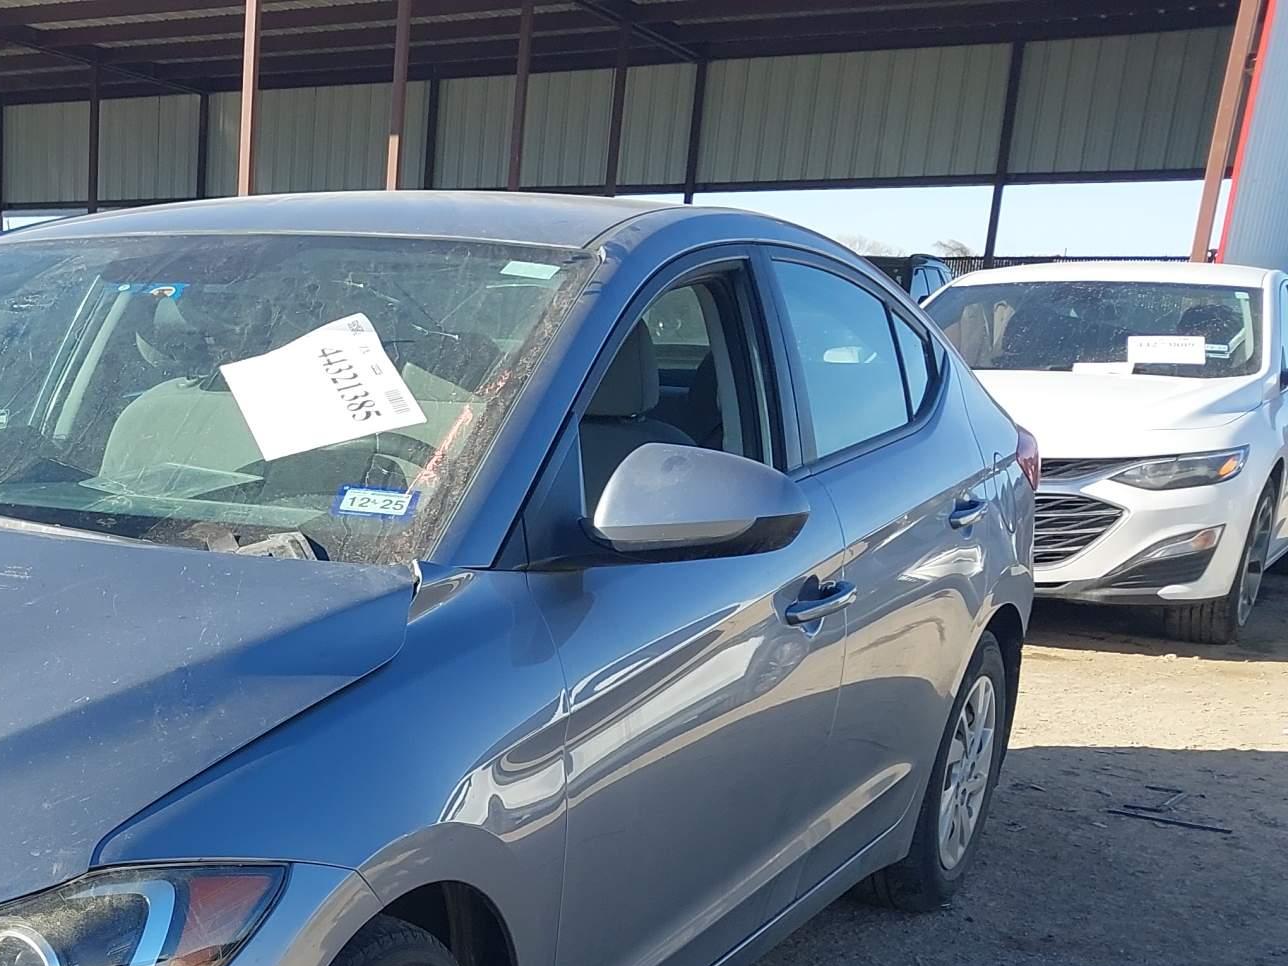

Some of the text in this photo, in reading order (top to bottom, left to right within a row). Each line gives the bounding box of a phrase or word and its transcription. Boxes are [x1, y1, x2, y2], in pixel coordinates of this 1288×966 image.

[317, 347, 383, 422] 44321385
[348, 496, 407, 511] 12 25
